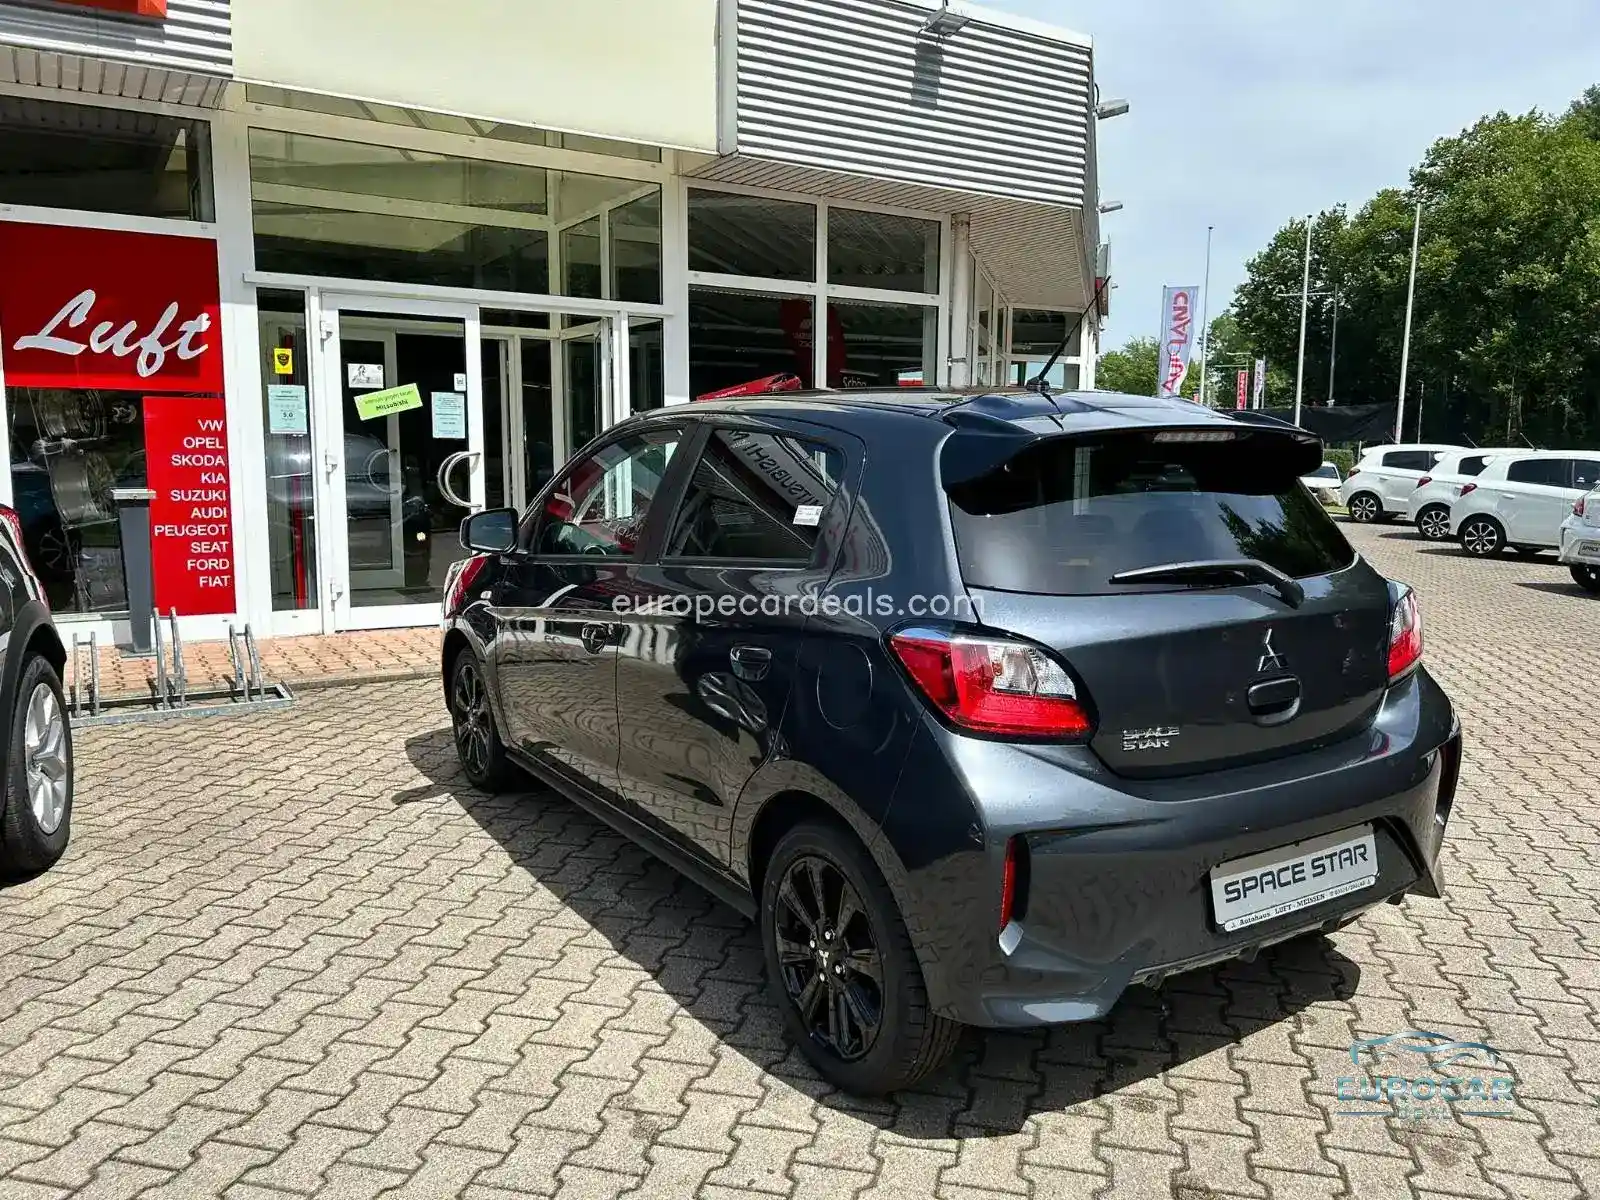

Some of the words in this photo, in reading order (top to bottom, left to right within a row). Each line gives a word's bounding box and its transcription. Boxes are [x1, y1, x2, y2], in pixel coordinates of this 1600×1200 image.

[13, 289, 211, 377] Luft
[198, 419, 223, 431] VW
[183, 437, 224, 449] OPEL
[171, 454, 225, 466] SKODA
[201, 472, 226, 484] KIA
[170, 489, 227, 501] SUZUKI
[191, 507, 227, 518] AUDI
[154, 524, 228, 537] PEUGEOT
[191, 541, 229, 553] SEAT
[187, 558, 230, 571] FORD
[199, 575, 231, 587] FIAT
[1122, 726, 1180, 740] SPACE
[1122, 738, 1170, 751] STAR
[1224, 862, 1306, 903] SPACE
[1311, 844, 1368, 877] STAR
[1239, 911, 1271, 926] Autohaus
[1274, 904, 1293, 915] LUFT
[1296, 893, 1326, 908] MEISSEN
